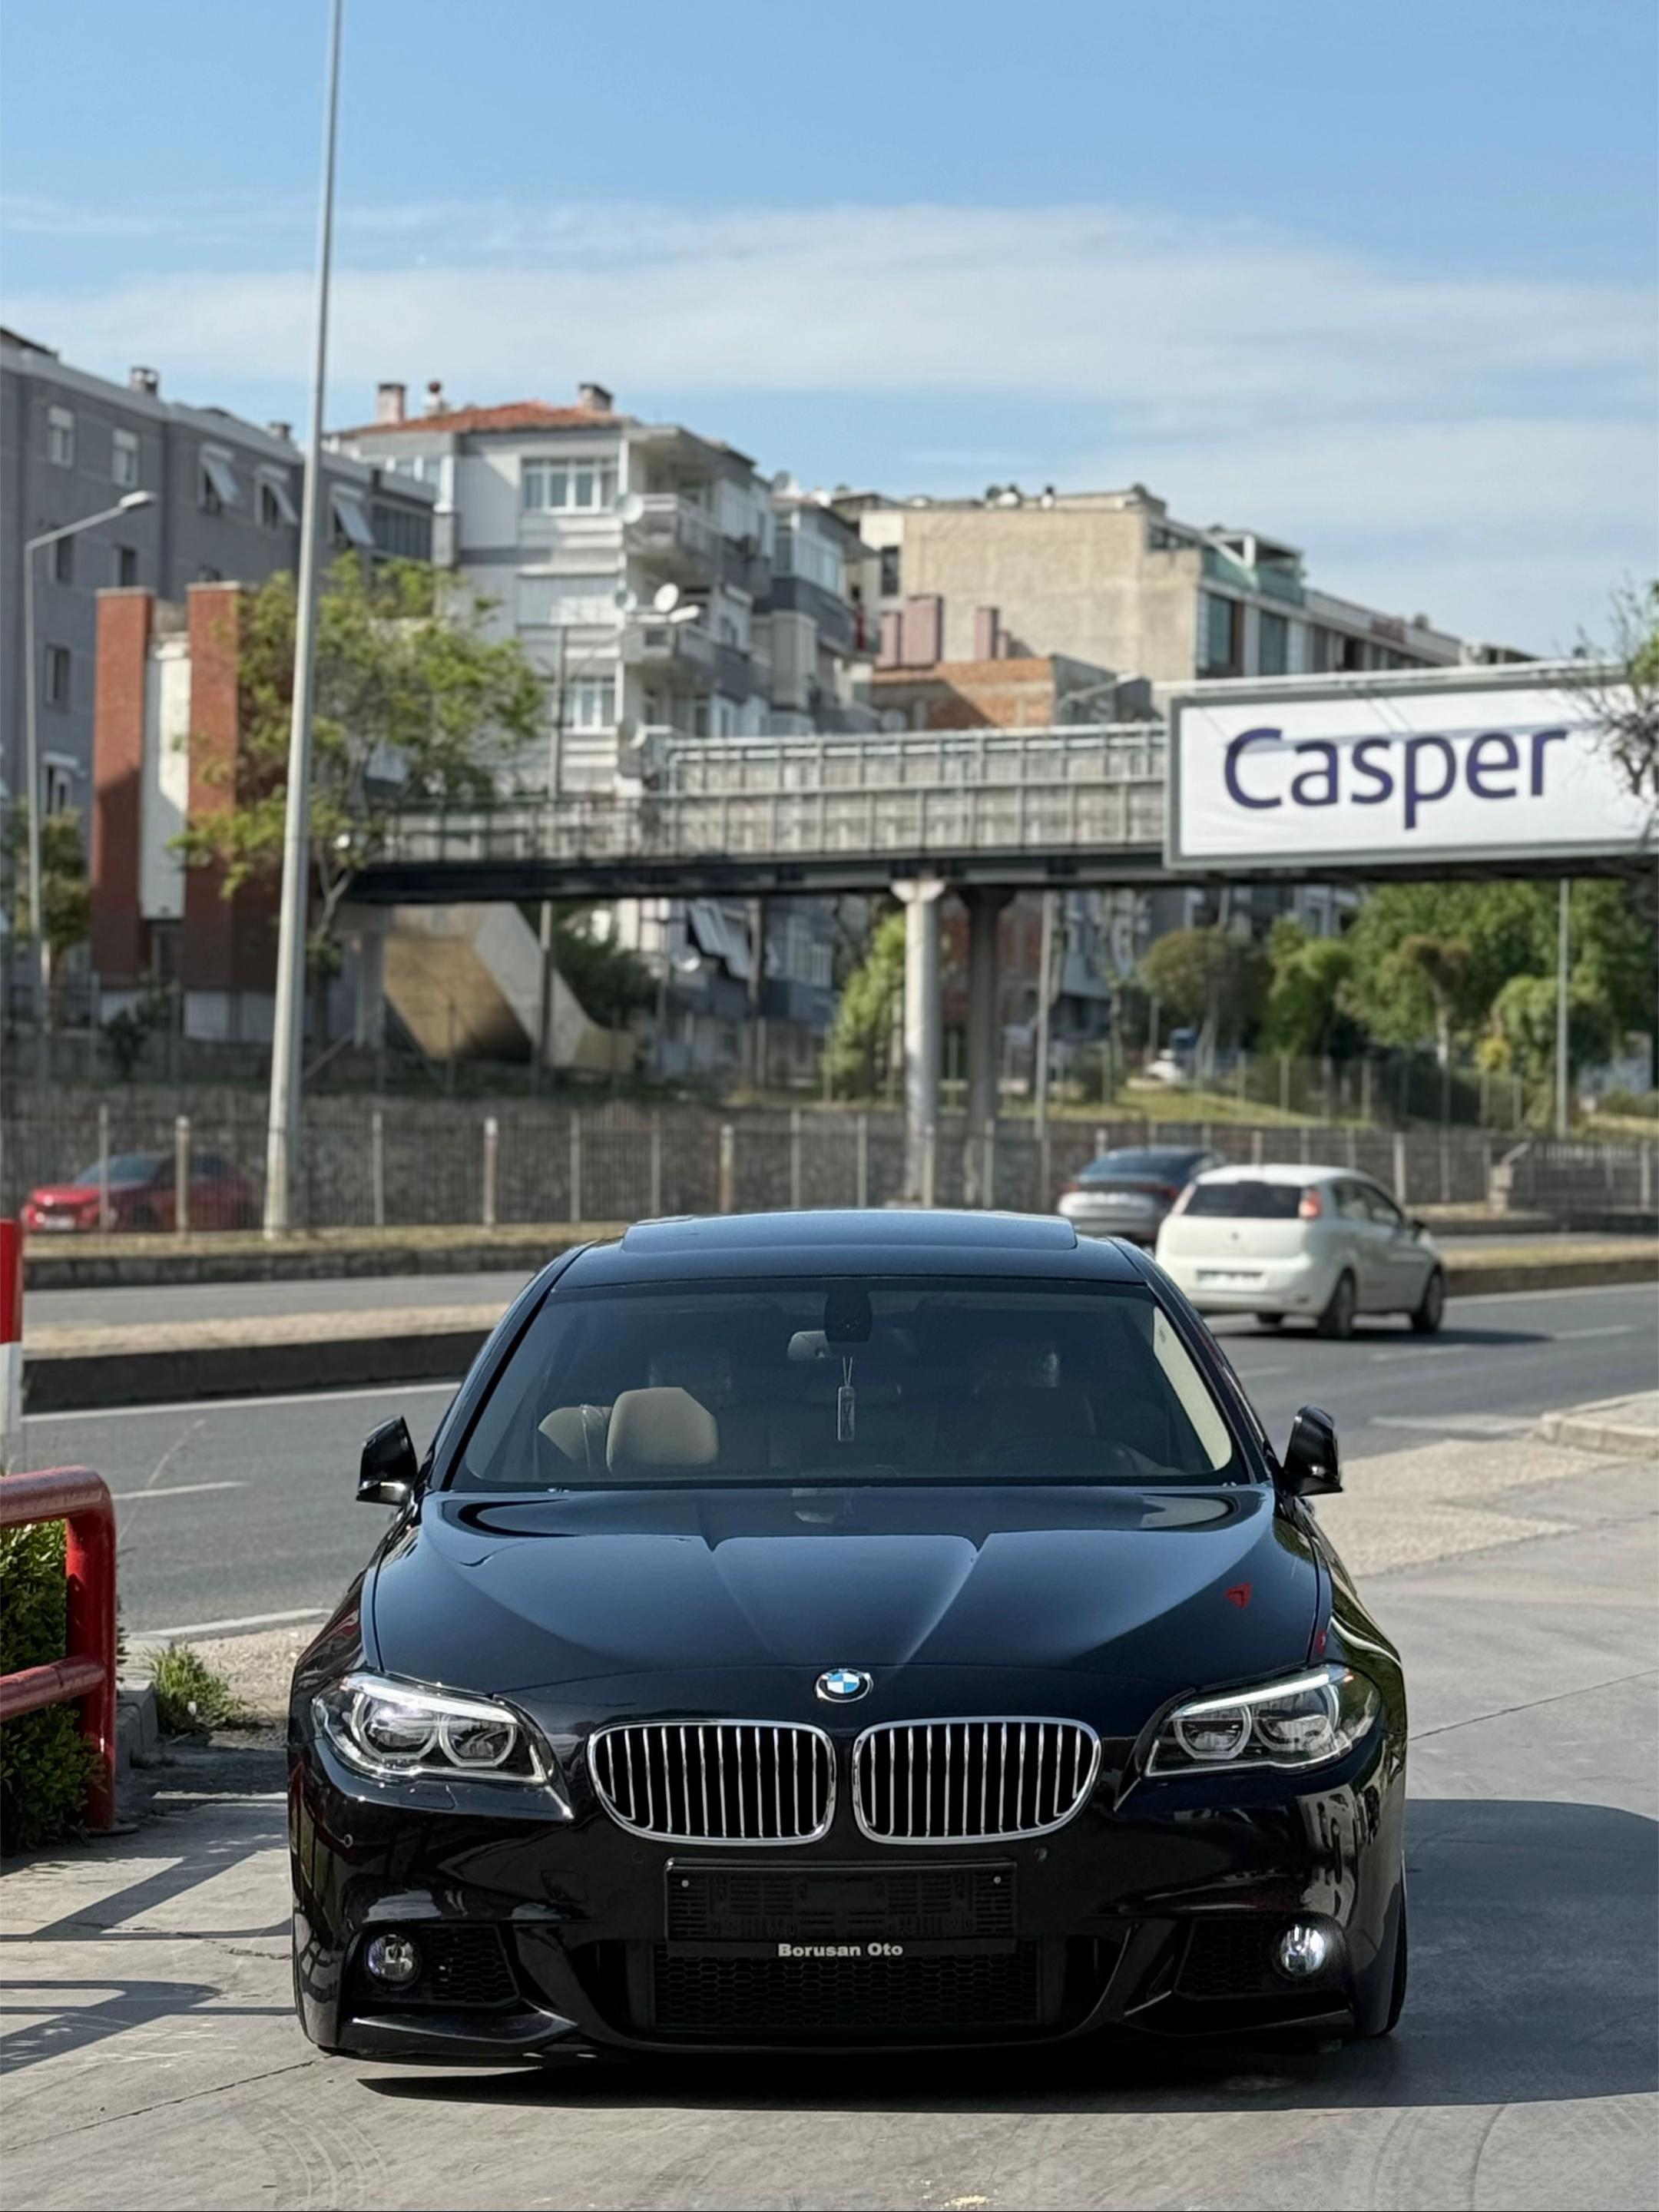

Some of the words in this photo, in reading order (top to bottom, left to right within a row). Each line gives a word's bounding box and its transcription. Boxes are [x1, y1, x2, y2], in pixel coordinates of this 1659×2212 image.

[1224, 727, 1568, 830] Casper
[778, 1943, 861, 1957] Borusan
[867, 1942, 903, 1956] Oto
